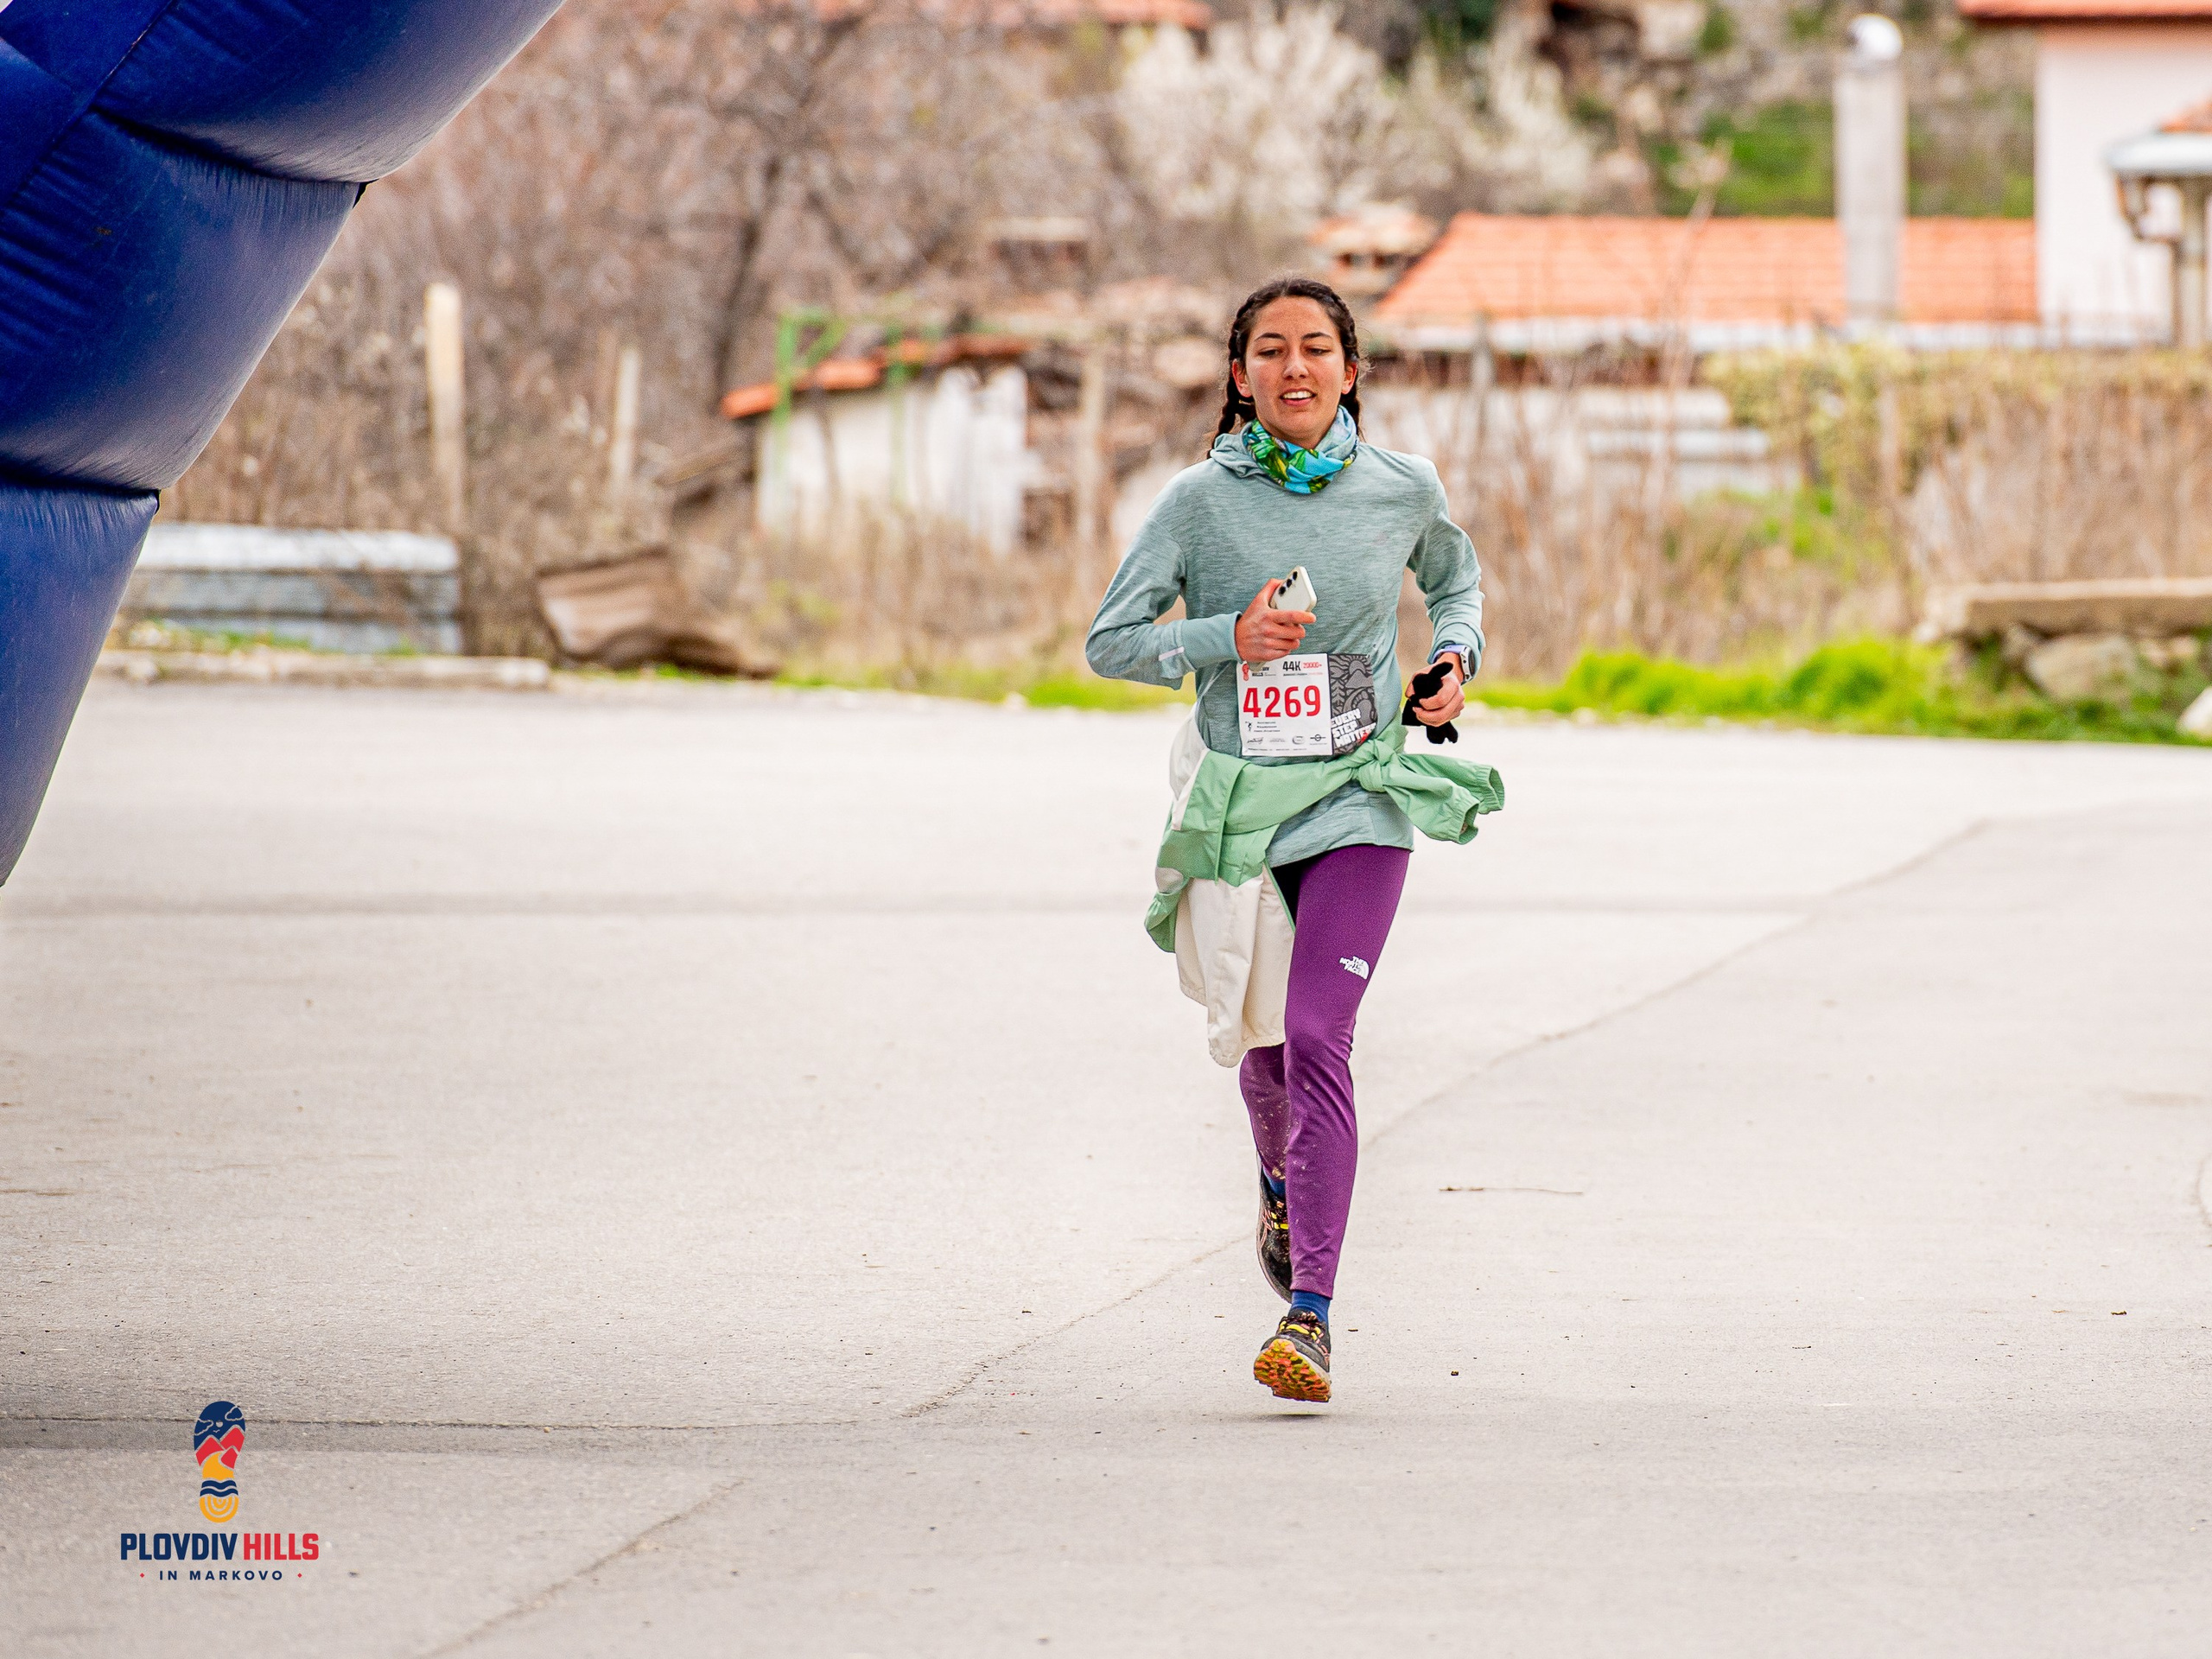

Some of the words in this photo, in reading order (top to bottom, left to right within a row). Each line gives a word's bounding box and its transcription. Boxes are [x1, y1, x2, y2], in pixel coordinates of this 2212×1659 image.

[1282, 660, 1301, 671] 44K
[1243, 685, 1320, 718] 4269
[1332, 721, 1357, 738] STEP
